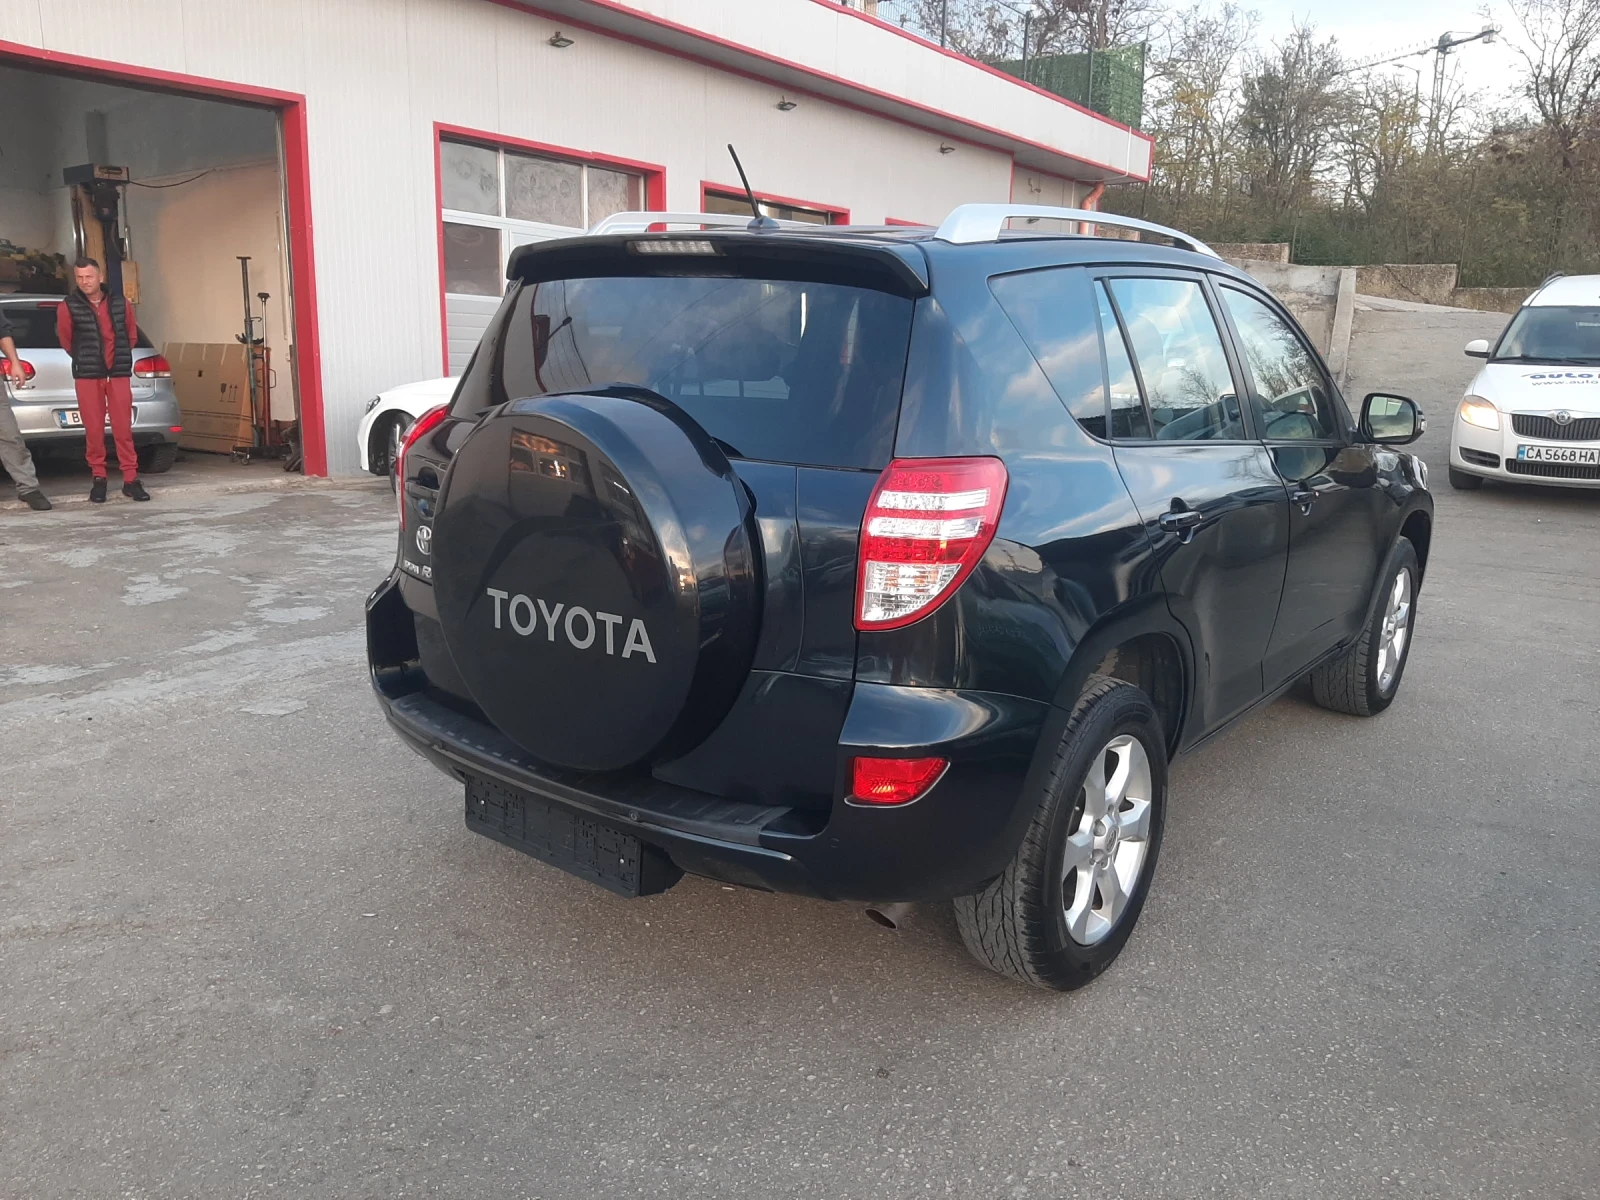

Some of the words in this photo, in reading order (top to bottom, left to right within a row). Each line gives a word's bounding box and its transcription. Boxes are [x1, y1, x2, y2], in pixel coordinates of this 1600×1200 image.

[1526, 448, 1542, 460] CA
[1545, 449, 1576, 462] 5668
[1579, 451, 1596, 463] HA
[486, 587, 657, 664] TOYOTA
